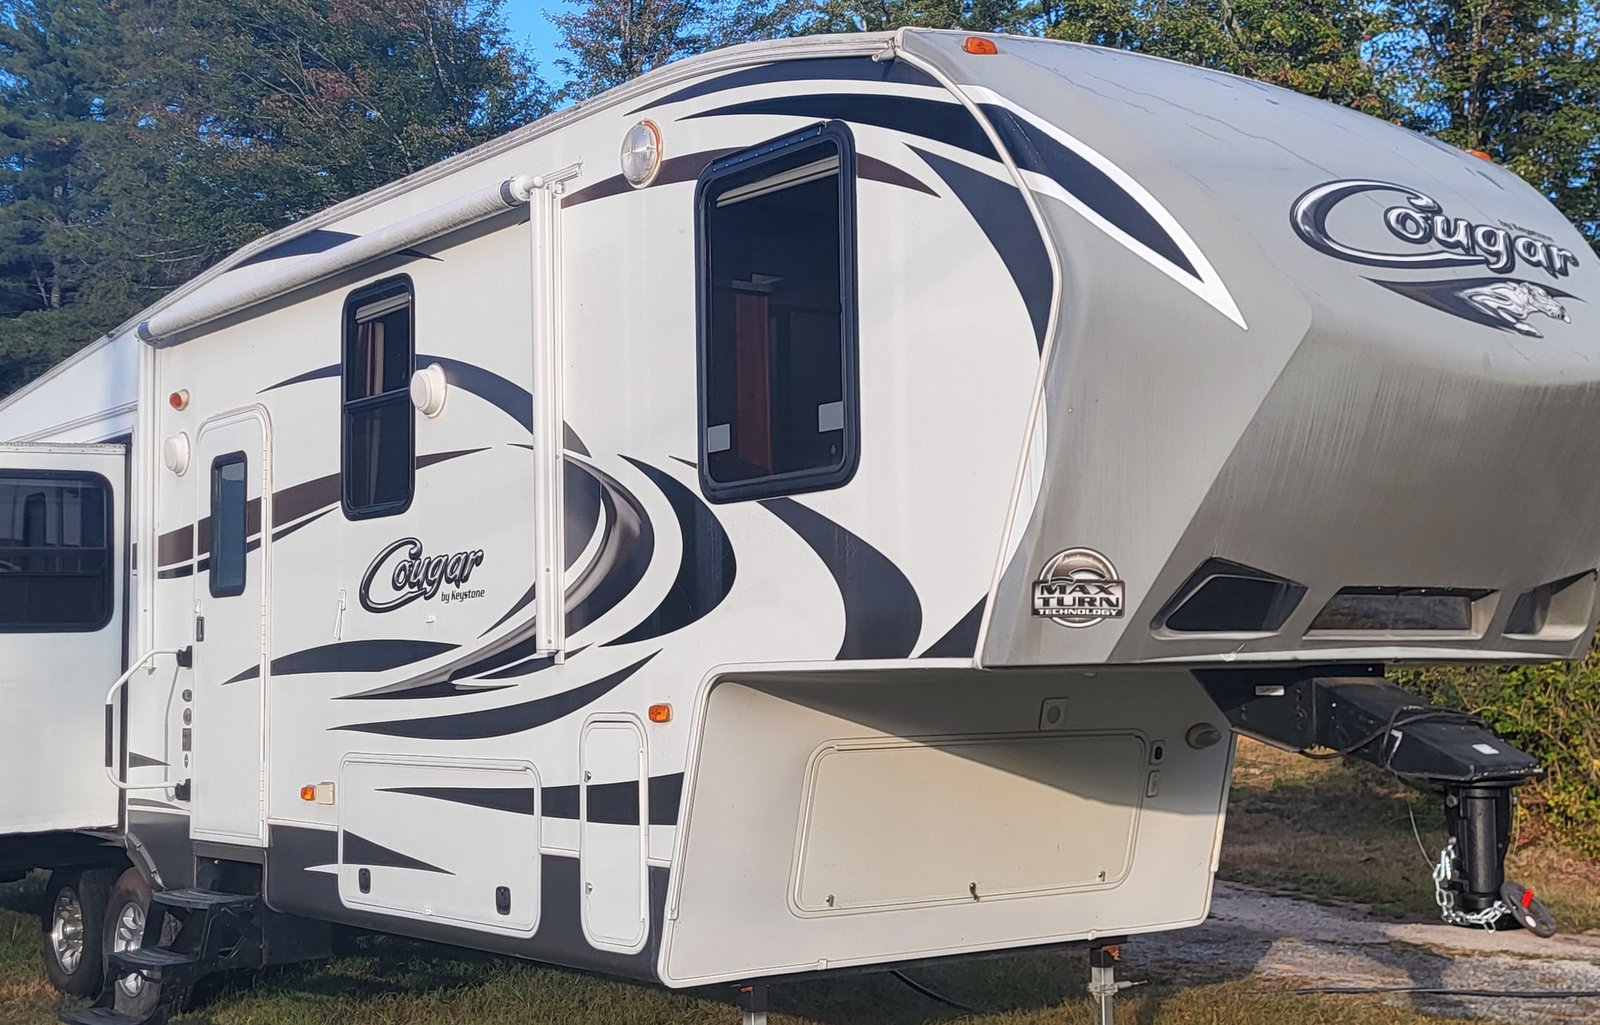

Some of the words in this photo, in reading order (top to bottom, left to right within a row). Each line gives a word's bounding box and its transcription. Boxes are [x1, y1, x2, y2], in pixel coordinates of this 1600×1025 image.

[1290, 179, 1579, 279] Cougar
[359, 537, 484, 613] Cougar
[1040, 583, 1116, 595] MAX
[441, 592, 450, 604] by
[451, 589, 485, 602] Keystone
[1037, 596, 1120, 608] TURN
[1038, 608, 1119, 616] TECHNOLOGY
